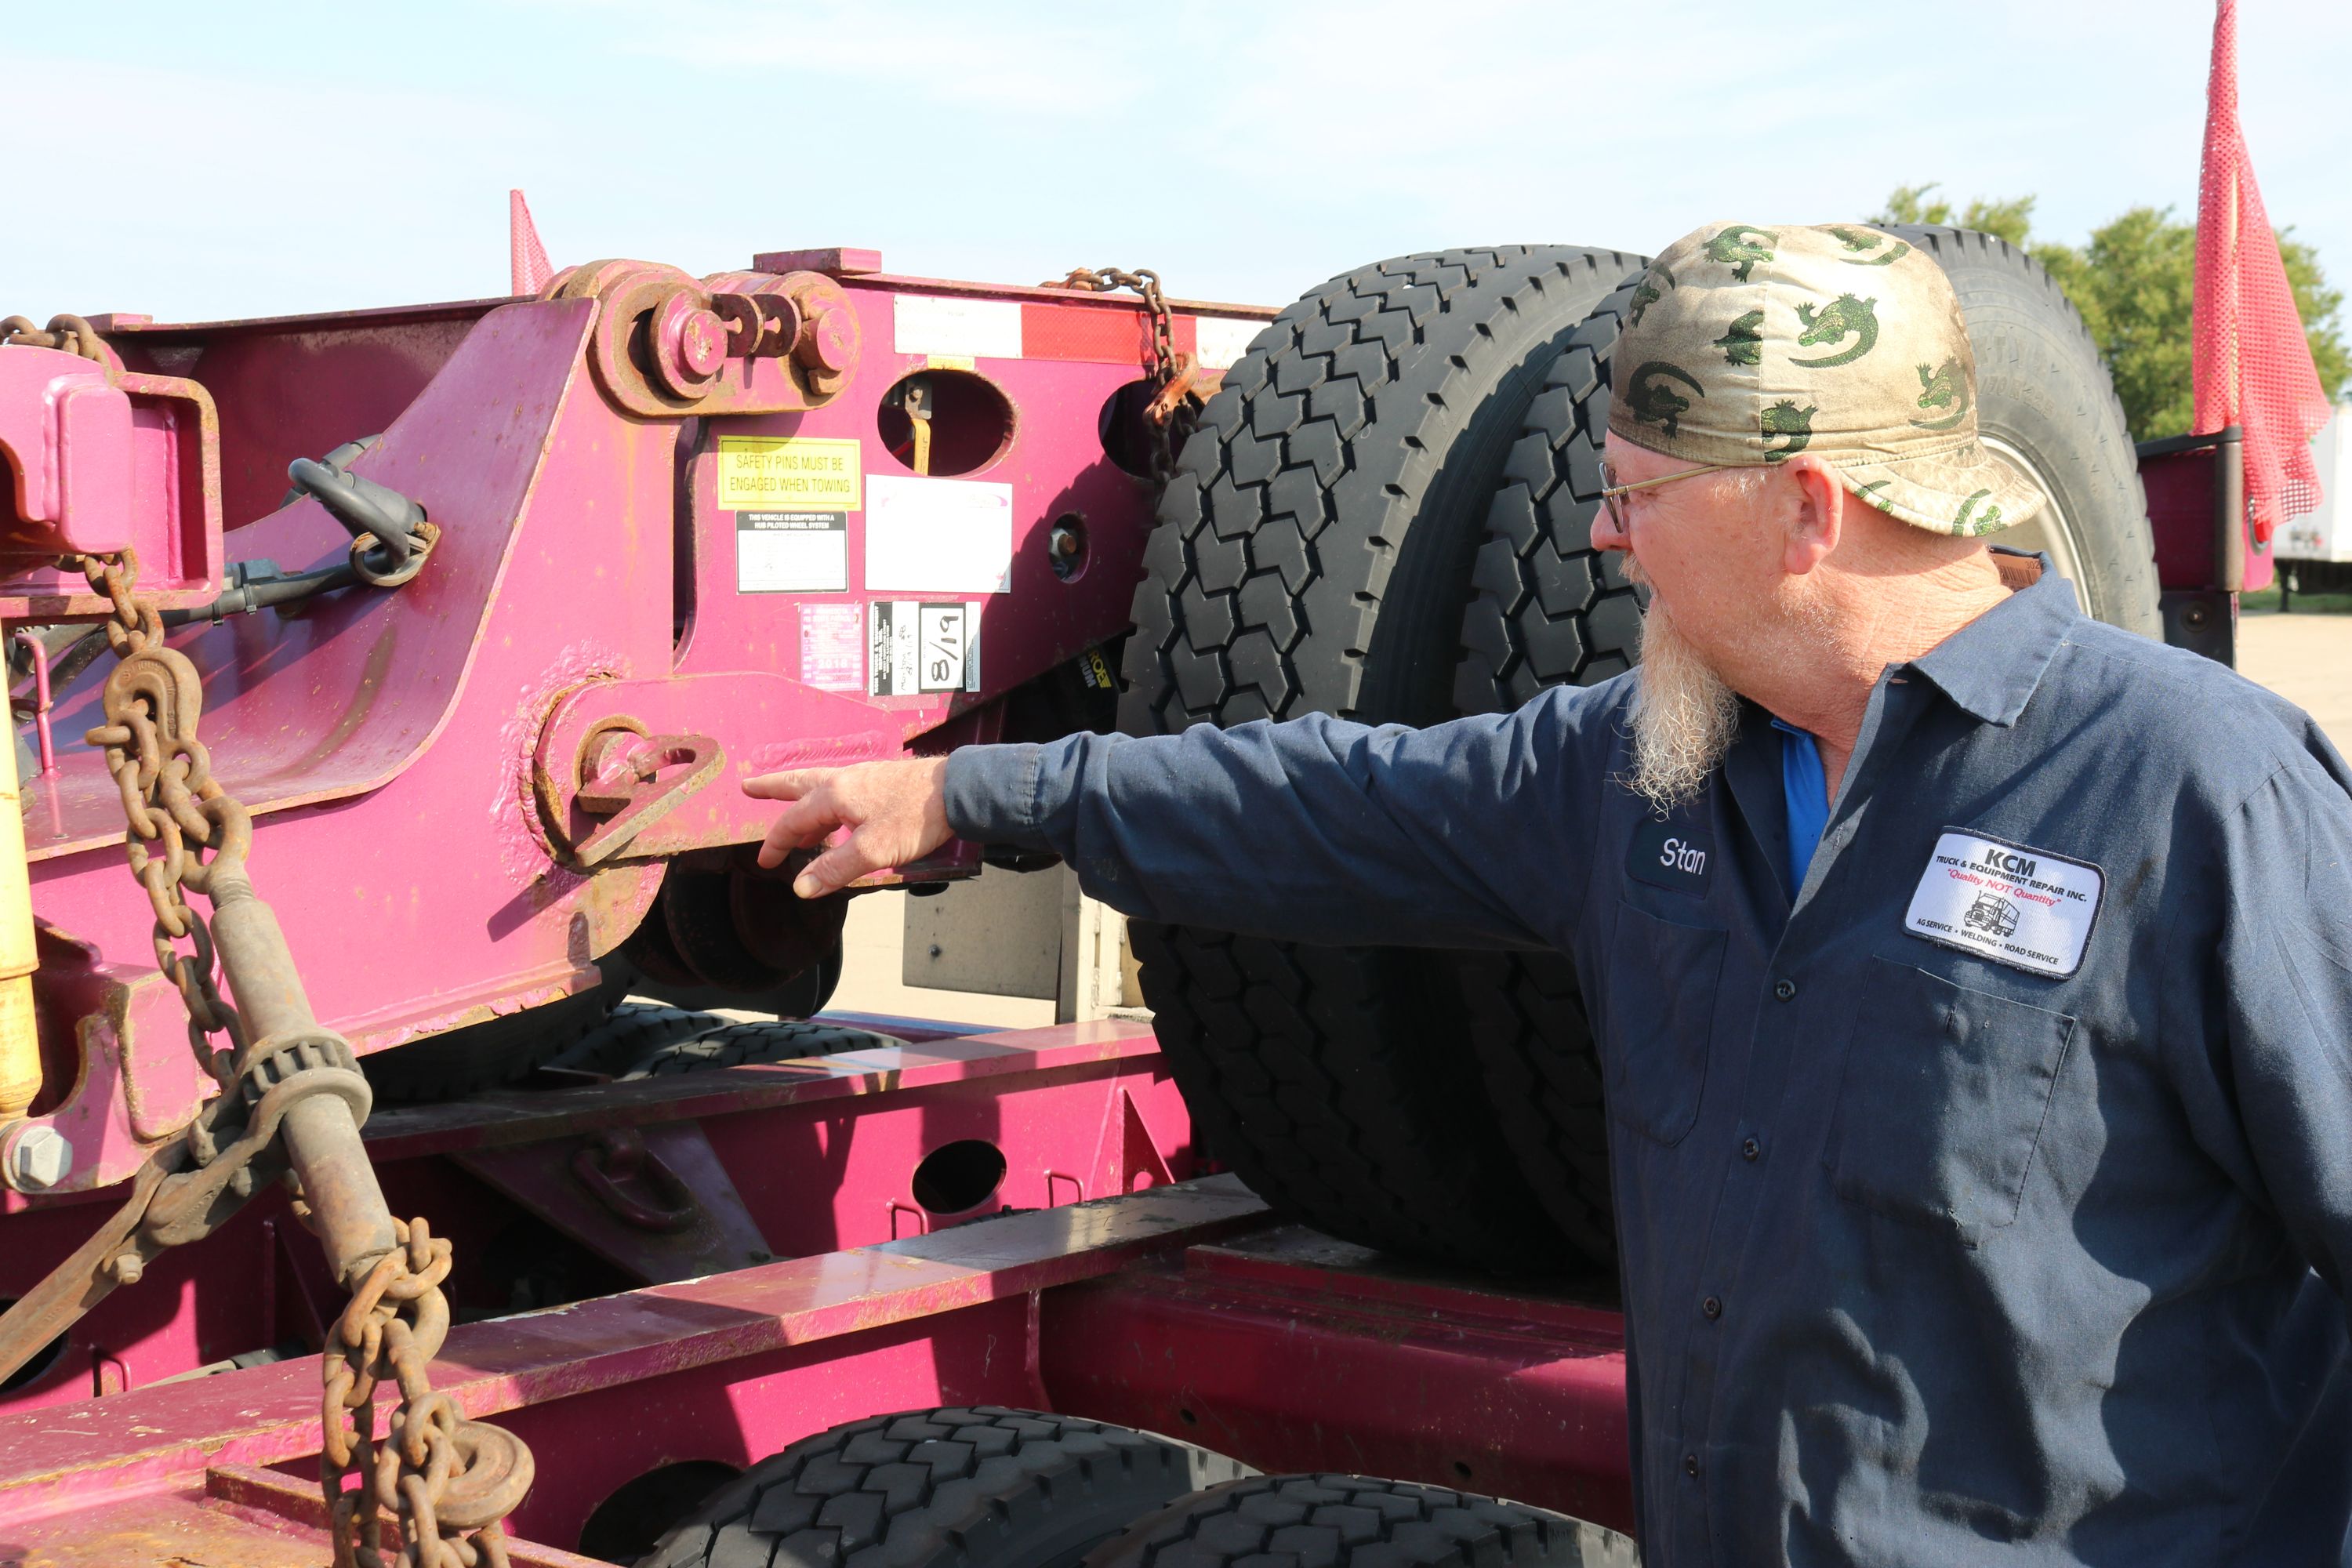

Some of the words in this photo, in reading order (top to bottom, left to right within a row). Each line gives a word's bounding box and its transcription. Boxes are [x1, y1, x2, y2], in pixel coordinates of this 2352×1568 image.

[736, 455, 772, 469] SAFETY
[775, 456, 798, 470] PINS
[801, 457, 829, 470] MUST
[832, 458, 844, 470] BE
[730, 477, 776, 492] ENGAGED
[779, 477, 808, 492] WHEN
[811, 478, 851, 492] TOWING
[929, 615, 959, 682] 8/19
[818, 659, 848, 669] 2018
[1660, 837, 1706, 875] Stan
[1984, 848, 2037, 877] KCM
[1936, 855, 1959, 866] TRUCK
[1969, 862, 2028, 885] EQUIPMENT
[2029, 879, 2065, 895] REPAIR
[2067, 890, 2087, 902] INC.
[1985, 880, 2013, 894] NOT
[1926, 920, 1953, 933] SERVICE
[1961, 929, 1998, 947] WELDING
[2004, 943, 2027, 956] ROAD
[2027, 949, 2060, 965] SERVICE
